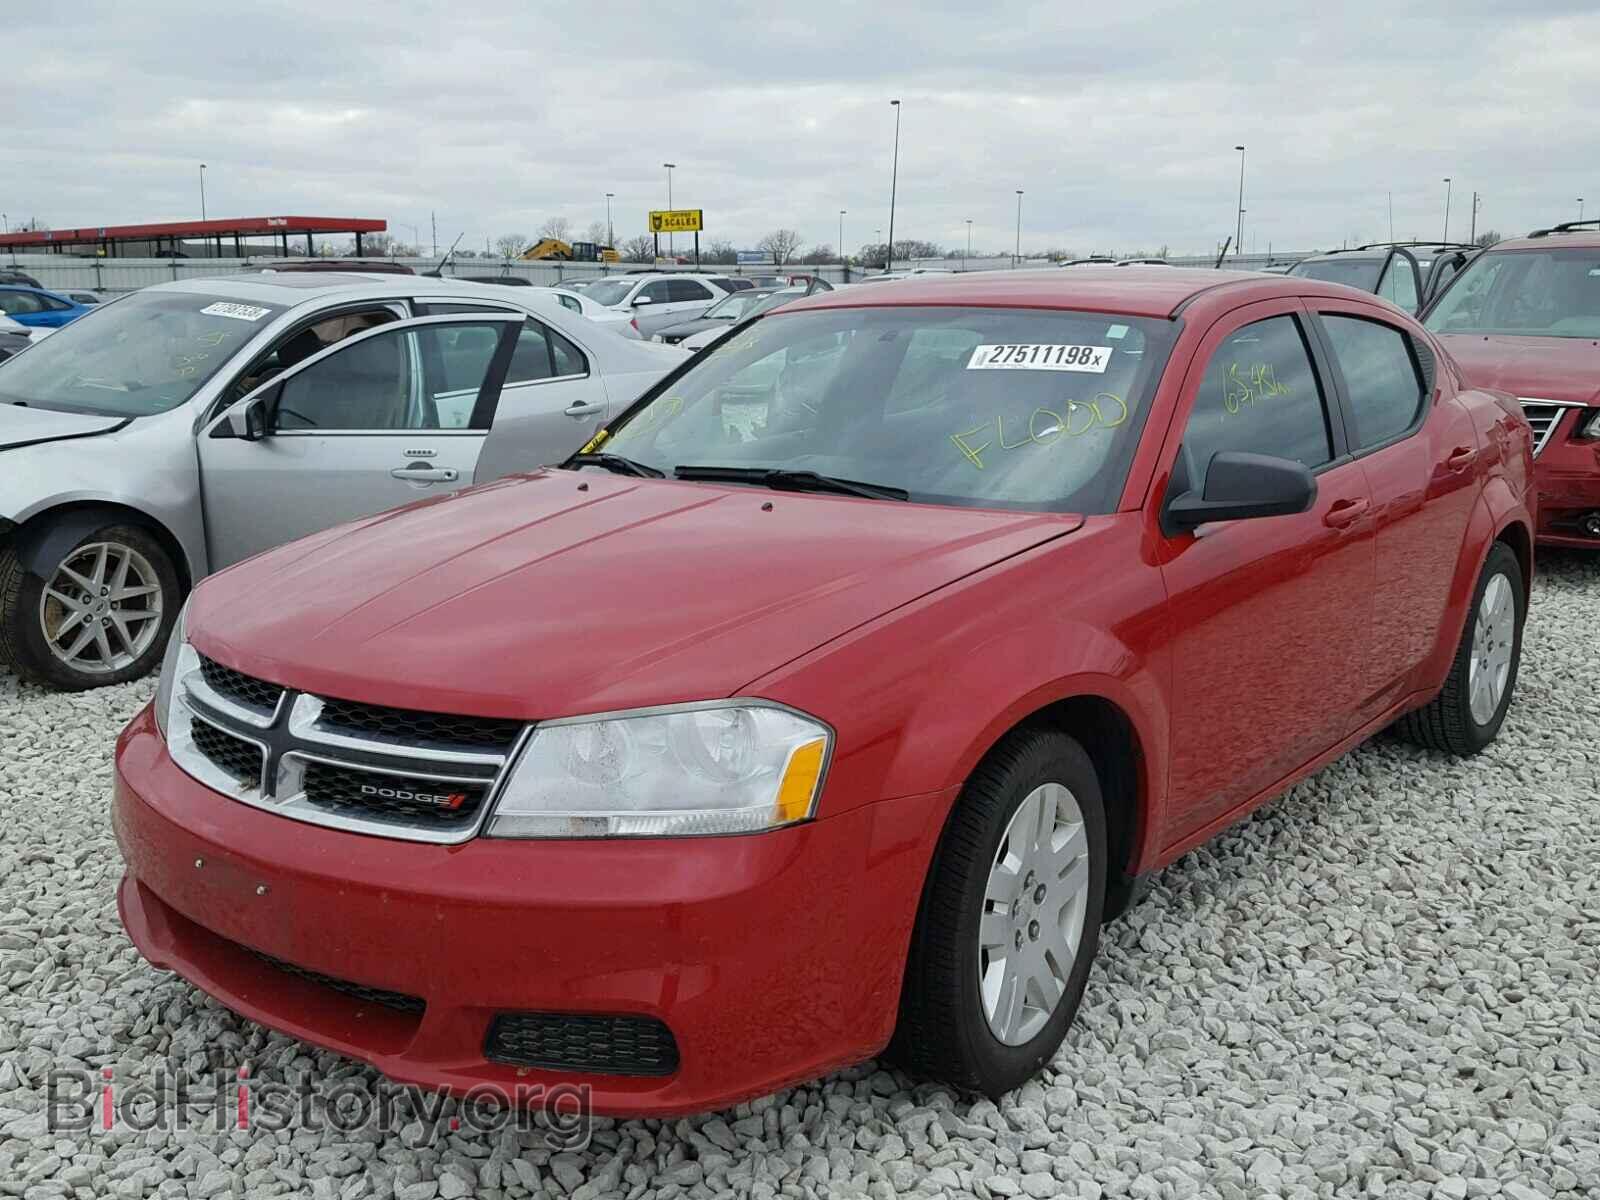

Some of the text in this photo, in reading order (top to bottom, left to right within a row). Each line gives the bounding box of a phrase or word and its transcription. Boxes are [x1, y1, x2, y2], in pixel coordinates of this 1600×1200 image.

[664, 217, 697, 226] SCALES
[949, 392, 1127, 469] FLOOD
[361, 785, 450, 804] DODGE
